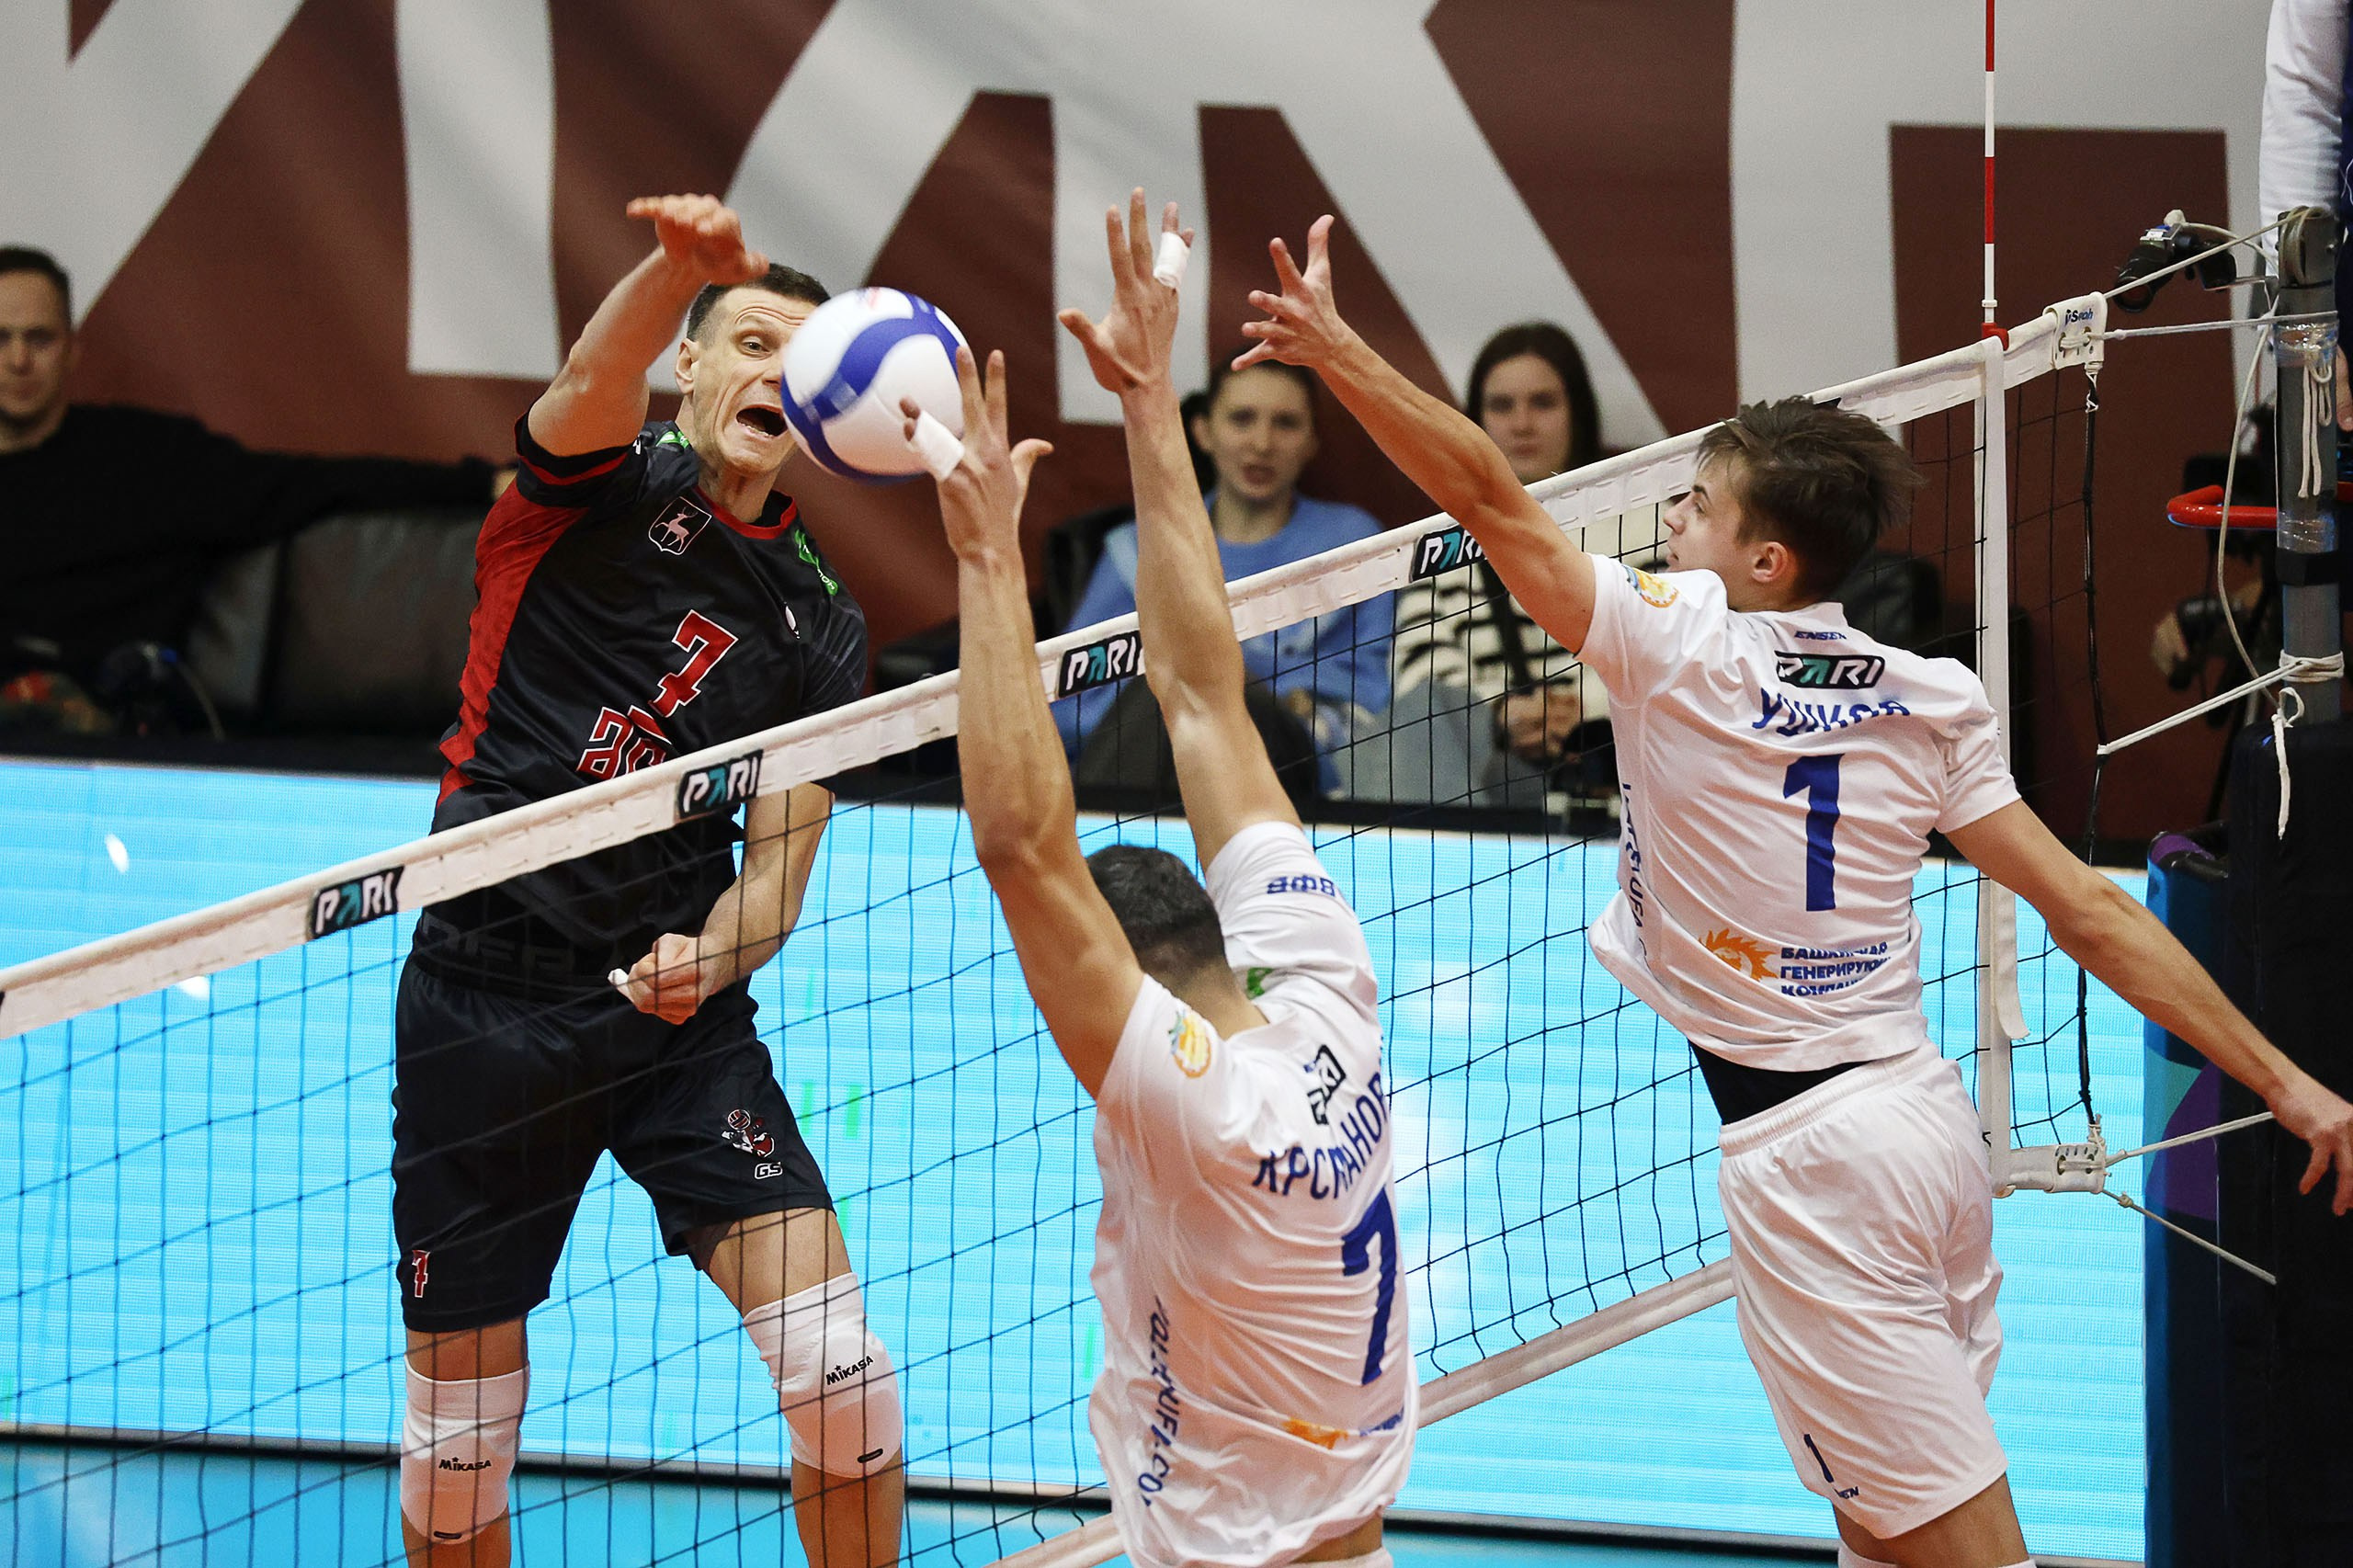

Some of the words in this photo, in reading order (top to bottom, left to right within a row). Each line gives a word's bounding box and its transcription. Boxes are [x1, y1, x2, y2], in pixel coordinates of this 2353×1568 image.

[648, 608, 739, 718] 7
[1066, 636, 1137, 691] PARI
[1777, 655, 1882, 687] PARI
[683, 756, 759, 813] PARI
[1782, 754, 1845, 913] 1
[315, 871, 395, 935] PARI
[755, 1162, 783, 1179] GS
[1341, 1187, 1398, 1385] 7
